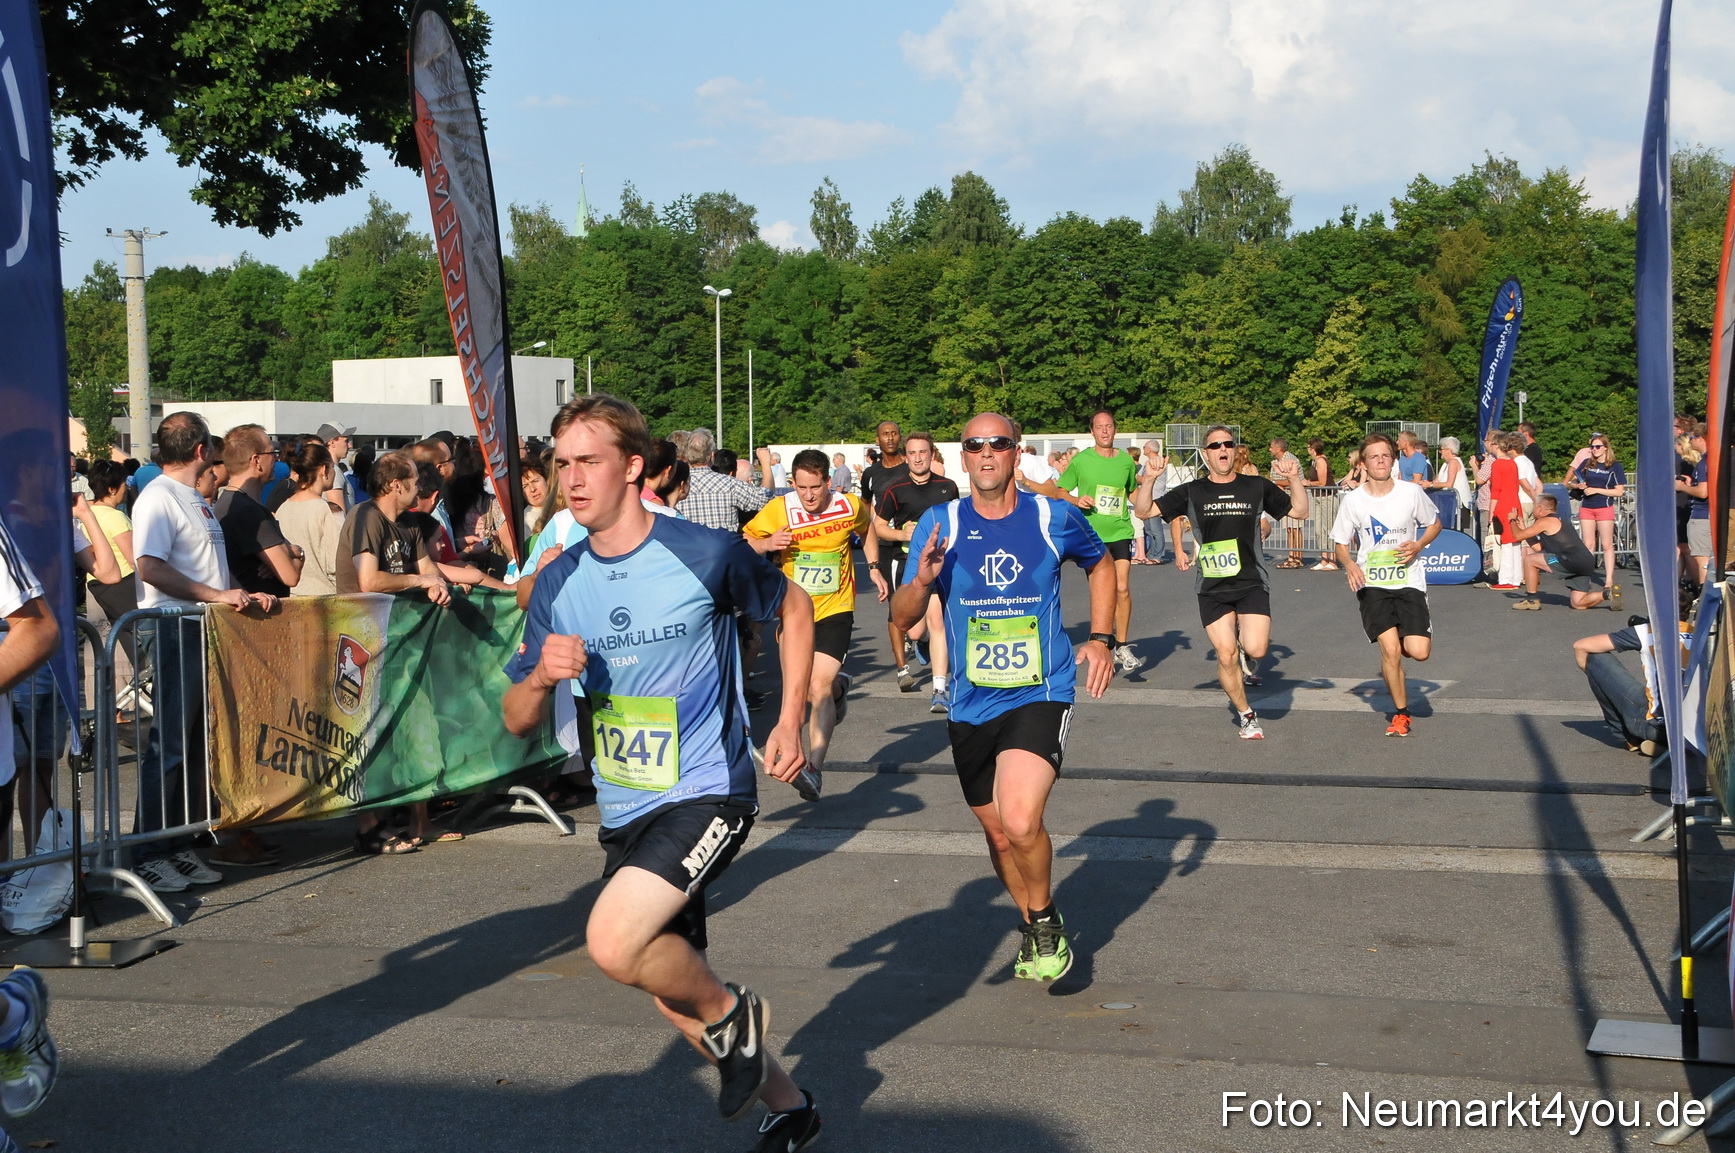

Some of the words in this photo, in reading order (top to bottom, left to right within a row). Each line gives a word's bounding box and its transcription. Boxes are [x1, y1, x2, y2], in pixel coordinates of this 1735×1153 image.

[1099, 496, 1120, 509] 574
[1203, 502, 1253, 511] SPORTNANKA
[791, 529, 821, 542] MAX
[1201, 552, 1238, 569] 1106
[799, 566, 833, 585] 773
[1368, 565, 1406, 580] 5076
[960, 593, 1042, 606] Kunststoffspritzerei
[976, 607, 1025, 617] Formenbau
[585, 622, 687, 653] HABMÜLLER
[609, 655, 639, 668] TEAM
[975, 641, 1029, 670] 285
[596, 722, 672, 767] 1247
[681, 816, 729, 878] NIKE
